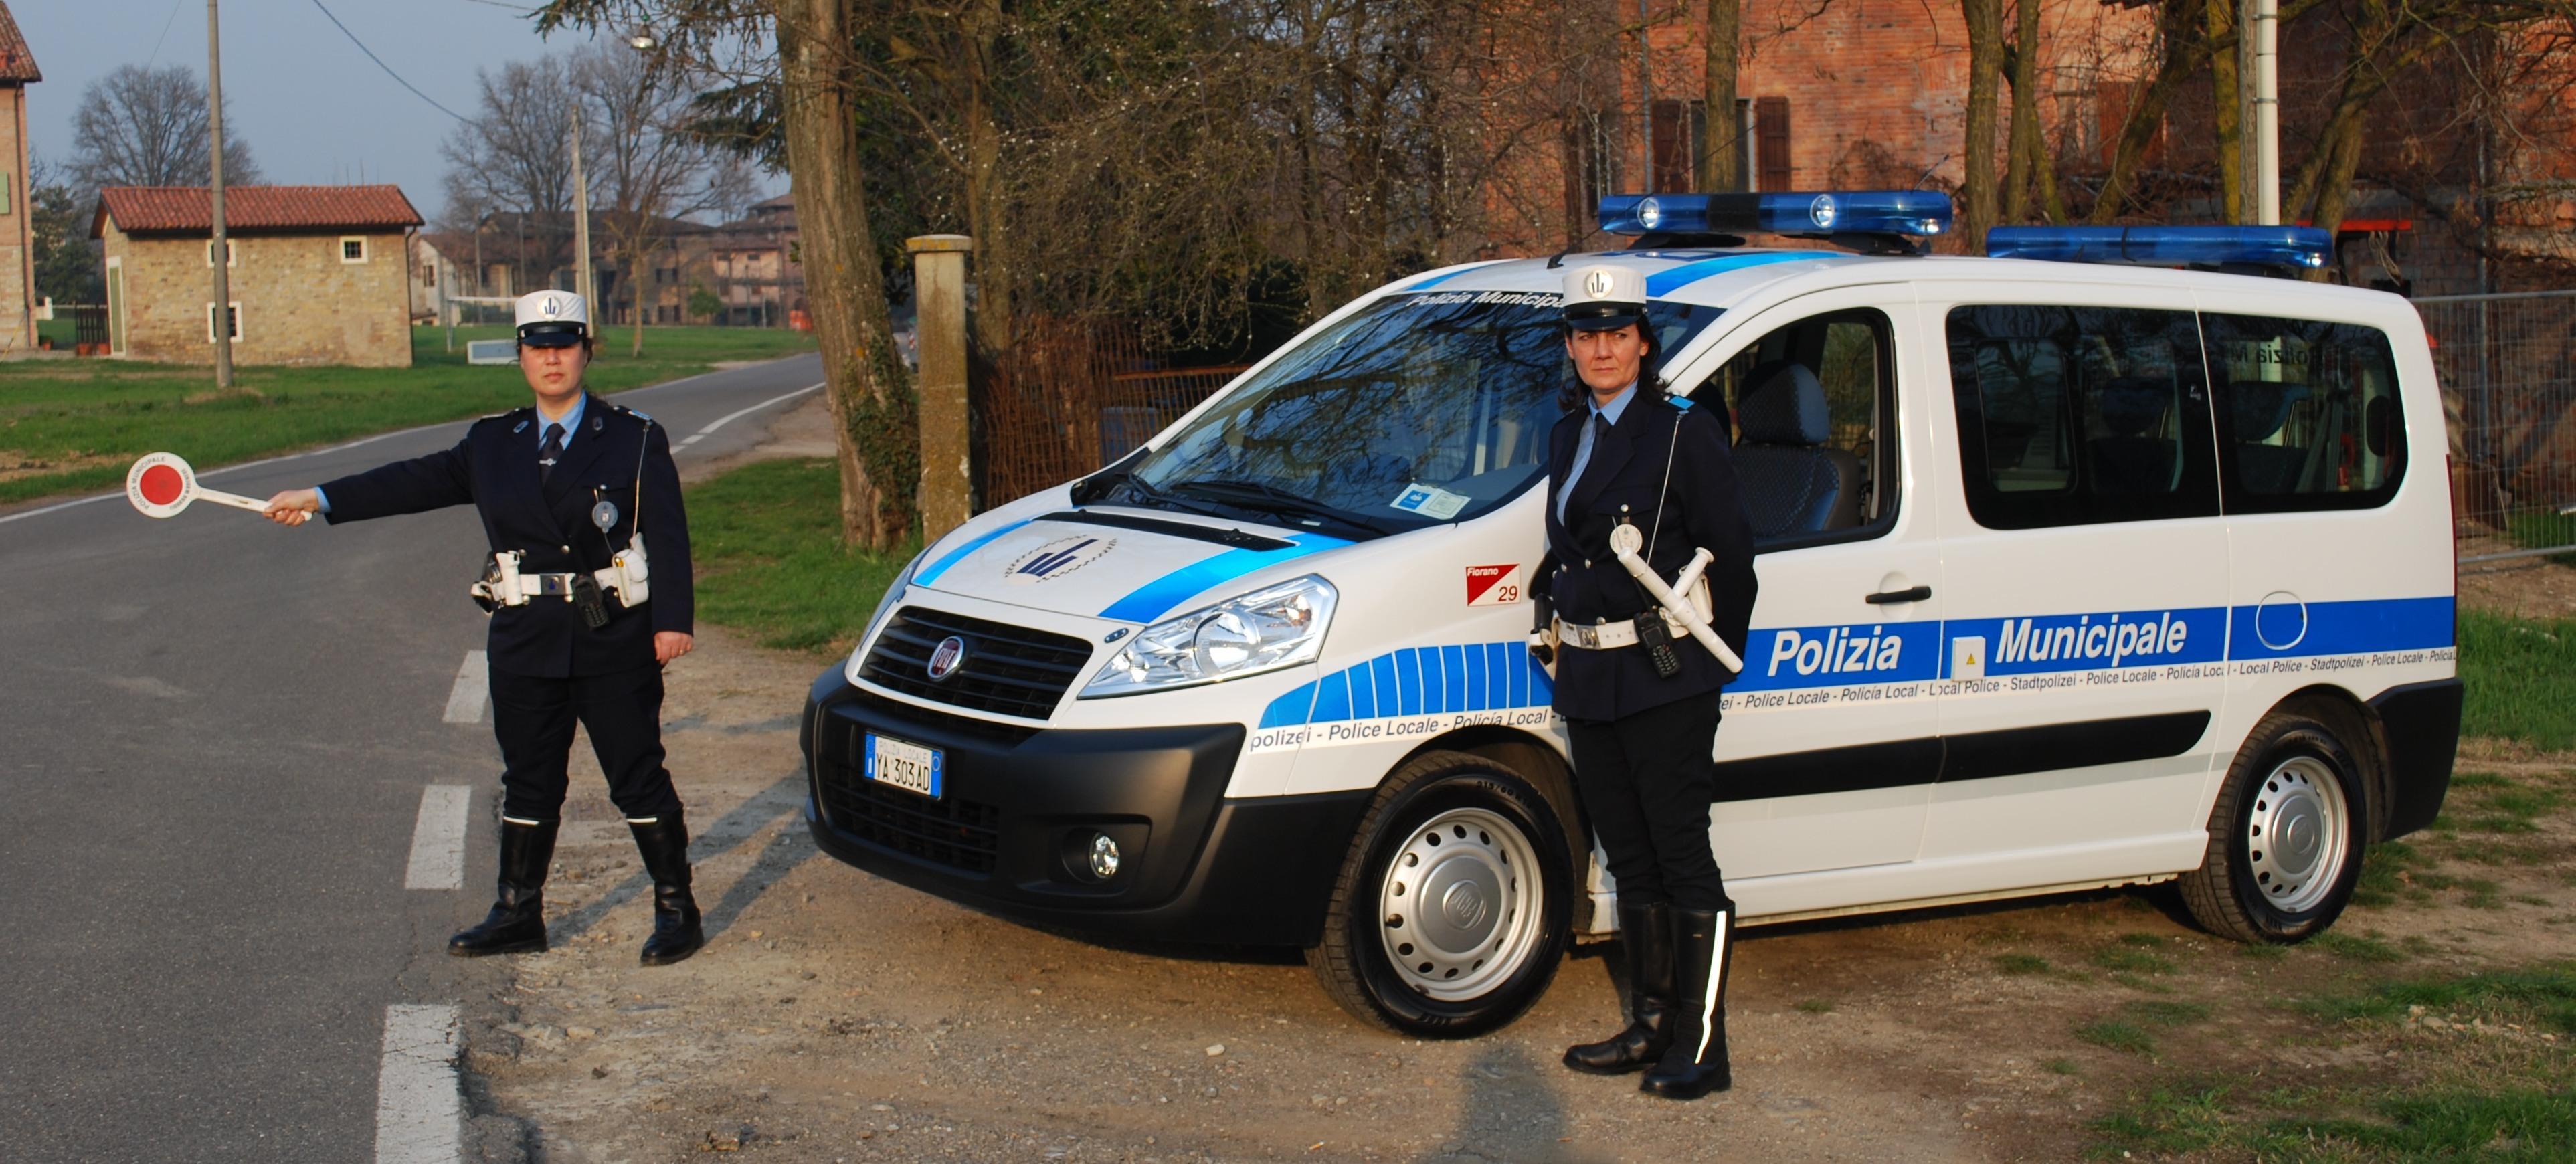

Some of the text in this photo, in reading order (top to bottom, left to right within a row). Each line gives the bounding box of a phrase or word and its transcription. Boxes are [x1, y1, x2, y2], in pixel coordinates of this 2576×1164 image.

[1406, 292, 1565, 308] Polizia Municipa
[132, 486, 150, 510] POLIZIA
[1467, 567, 1499, 576] Fiorano
[1497, 585, 1518, 601] 29
[1767, 625, 1902, 677] Polizia
[1995, 611, 2187, 668] Municipale
[1745, 693, 1784, 708] Police
[1788, 690, 1829, 705] Locale
[1885, 684, 1918, 698] Local
[1964, 679, 1999, 694] Police
[2011, 673, 2077, 692] Stadtpolizei
[2086, 671, 2119, 685] Police
[2122, 668, 2157, 682] Locale
[2239, 661, 2269, 674] Local
[2272, 660, 2302, 673] Police
[2310, 656, 2365, 673] Stadtpolizei
[2371, 652, 2395, 666] Police
[2397, 651, 2423, 664] Locale
[1250, 726, 1311, 752] polizei
[1329, 722, 1381, 740] Police
[1386, 718, 1439, 735] Locale
[1507, 709, 1548, 726] Local
